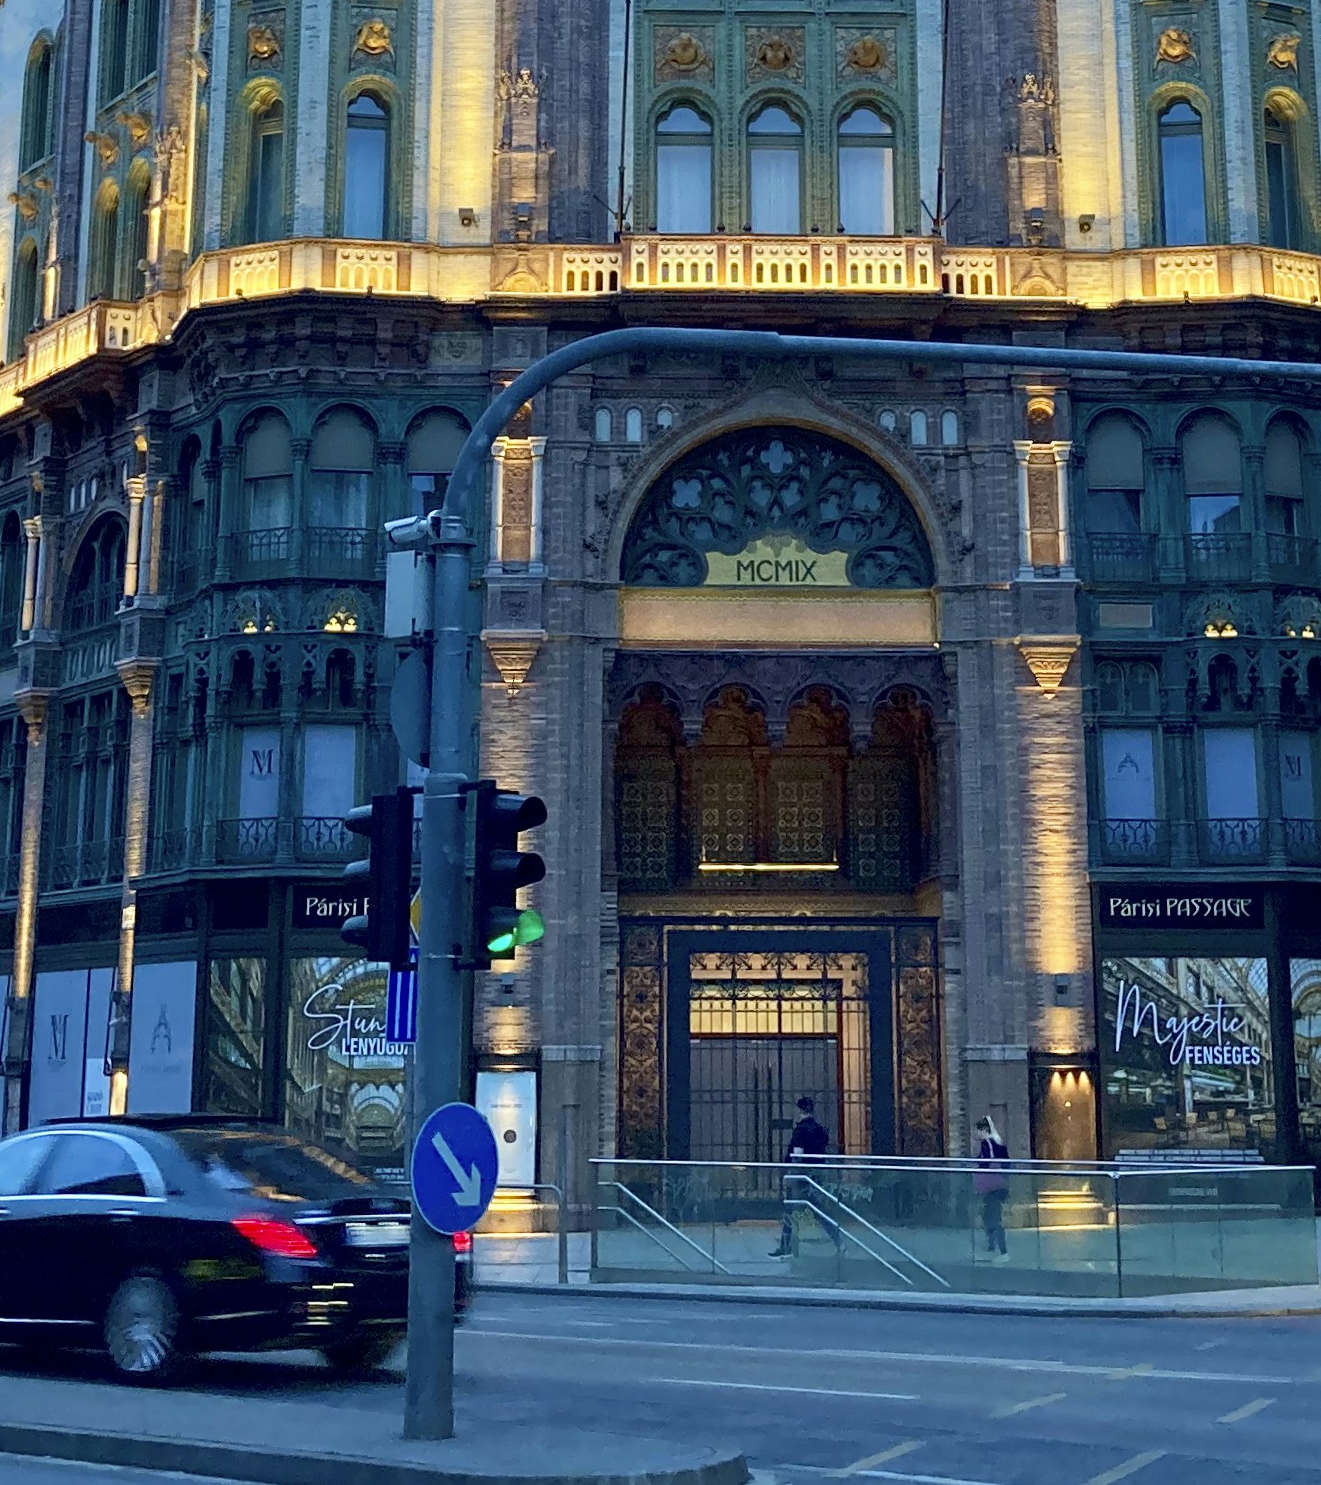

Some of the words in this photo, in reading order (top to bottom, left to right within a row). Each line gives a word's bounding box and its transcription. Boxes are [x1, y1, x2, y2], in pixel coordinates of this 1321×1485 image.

[736, 559, 817, 583] MCMIX
[1109, 898, 1161, 917] Párisi
[1166, 898, 1253, 917] PASSAGE
[303, 984, 388, 1050] Stun
[1115, 979, 1247, 1066] Majestic
[1185, 1041, 1261, 1065] FENSÉGES
